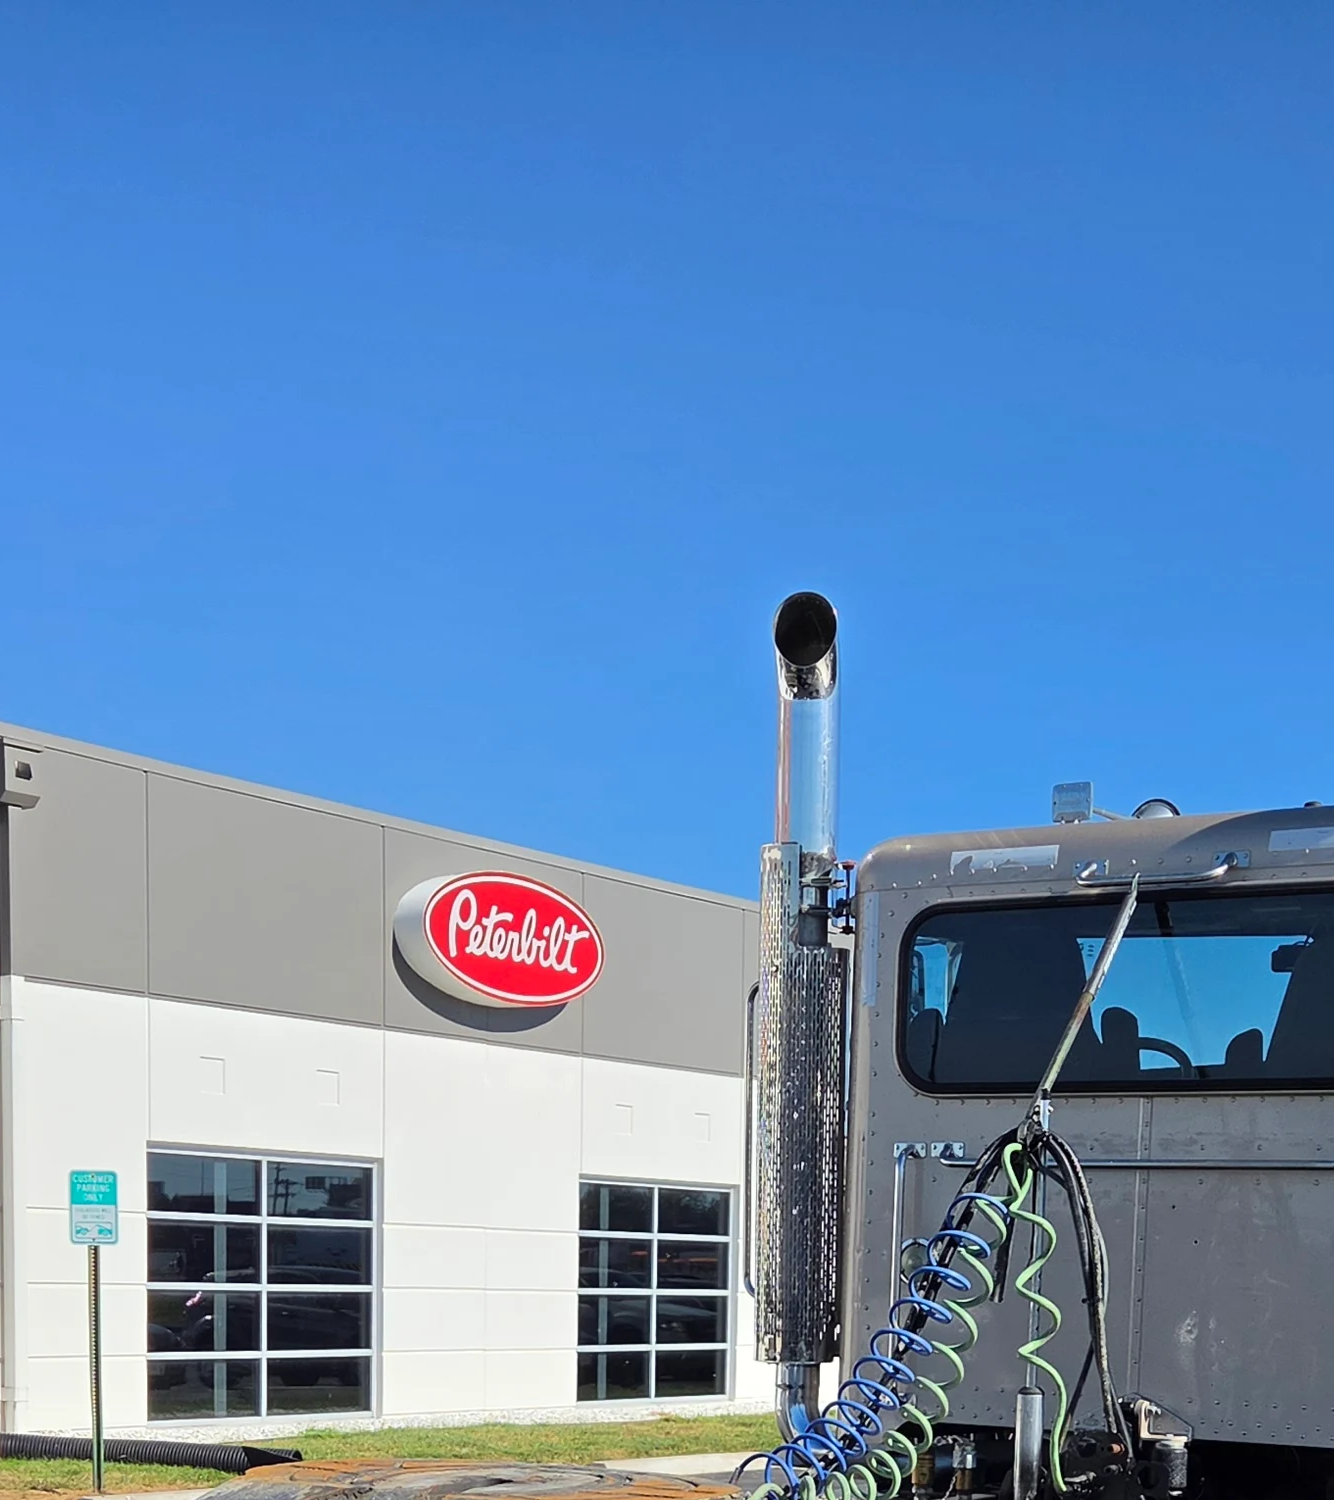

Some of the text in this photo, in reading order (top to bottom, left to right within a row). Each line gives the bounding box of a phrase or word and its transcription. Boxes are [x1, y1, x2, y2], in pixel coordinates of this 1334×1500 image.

[449, 888, 591, 974] Peterbilt
[76, 1184, 110, 1193] PARKING
[83, 1194, 103, 1202] ONLY
